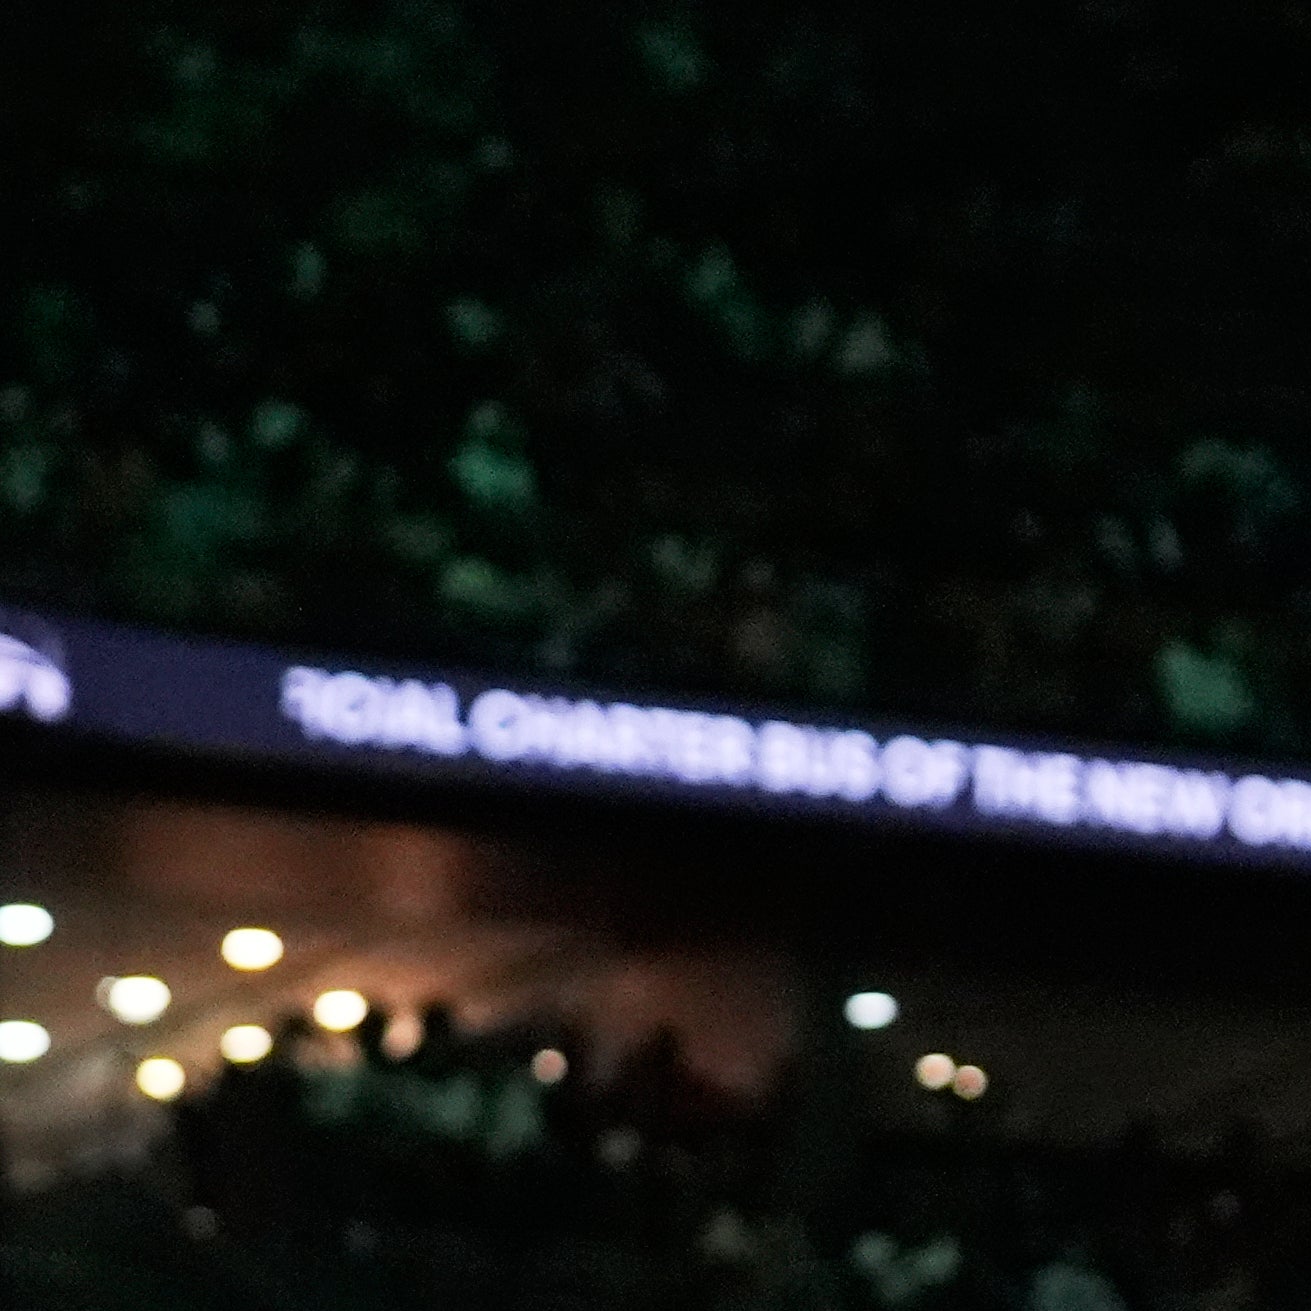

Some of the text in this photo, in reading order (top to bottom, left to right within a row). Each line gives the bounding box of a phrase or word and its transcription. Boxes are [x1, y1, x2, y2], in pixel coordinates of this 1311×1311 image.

[472, 691, 753, 783] CHARTER
[758, 722, 878, 800] BUS
[879, 737, 968, 805] OF
[974, 746, 1079, 824] THE
[1085, 761, 1224, 836] NEW
